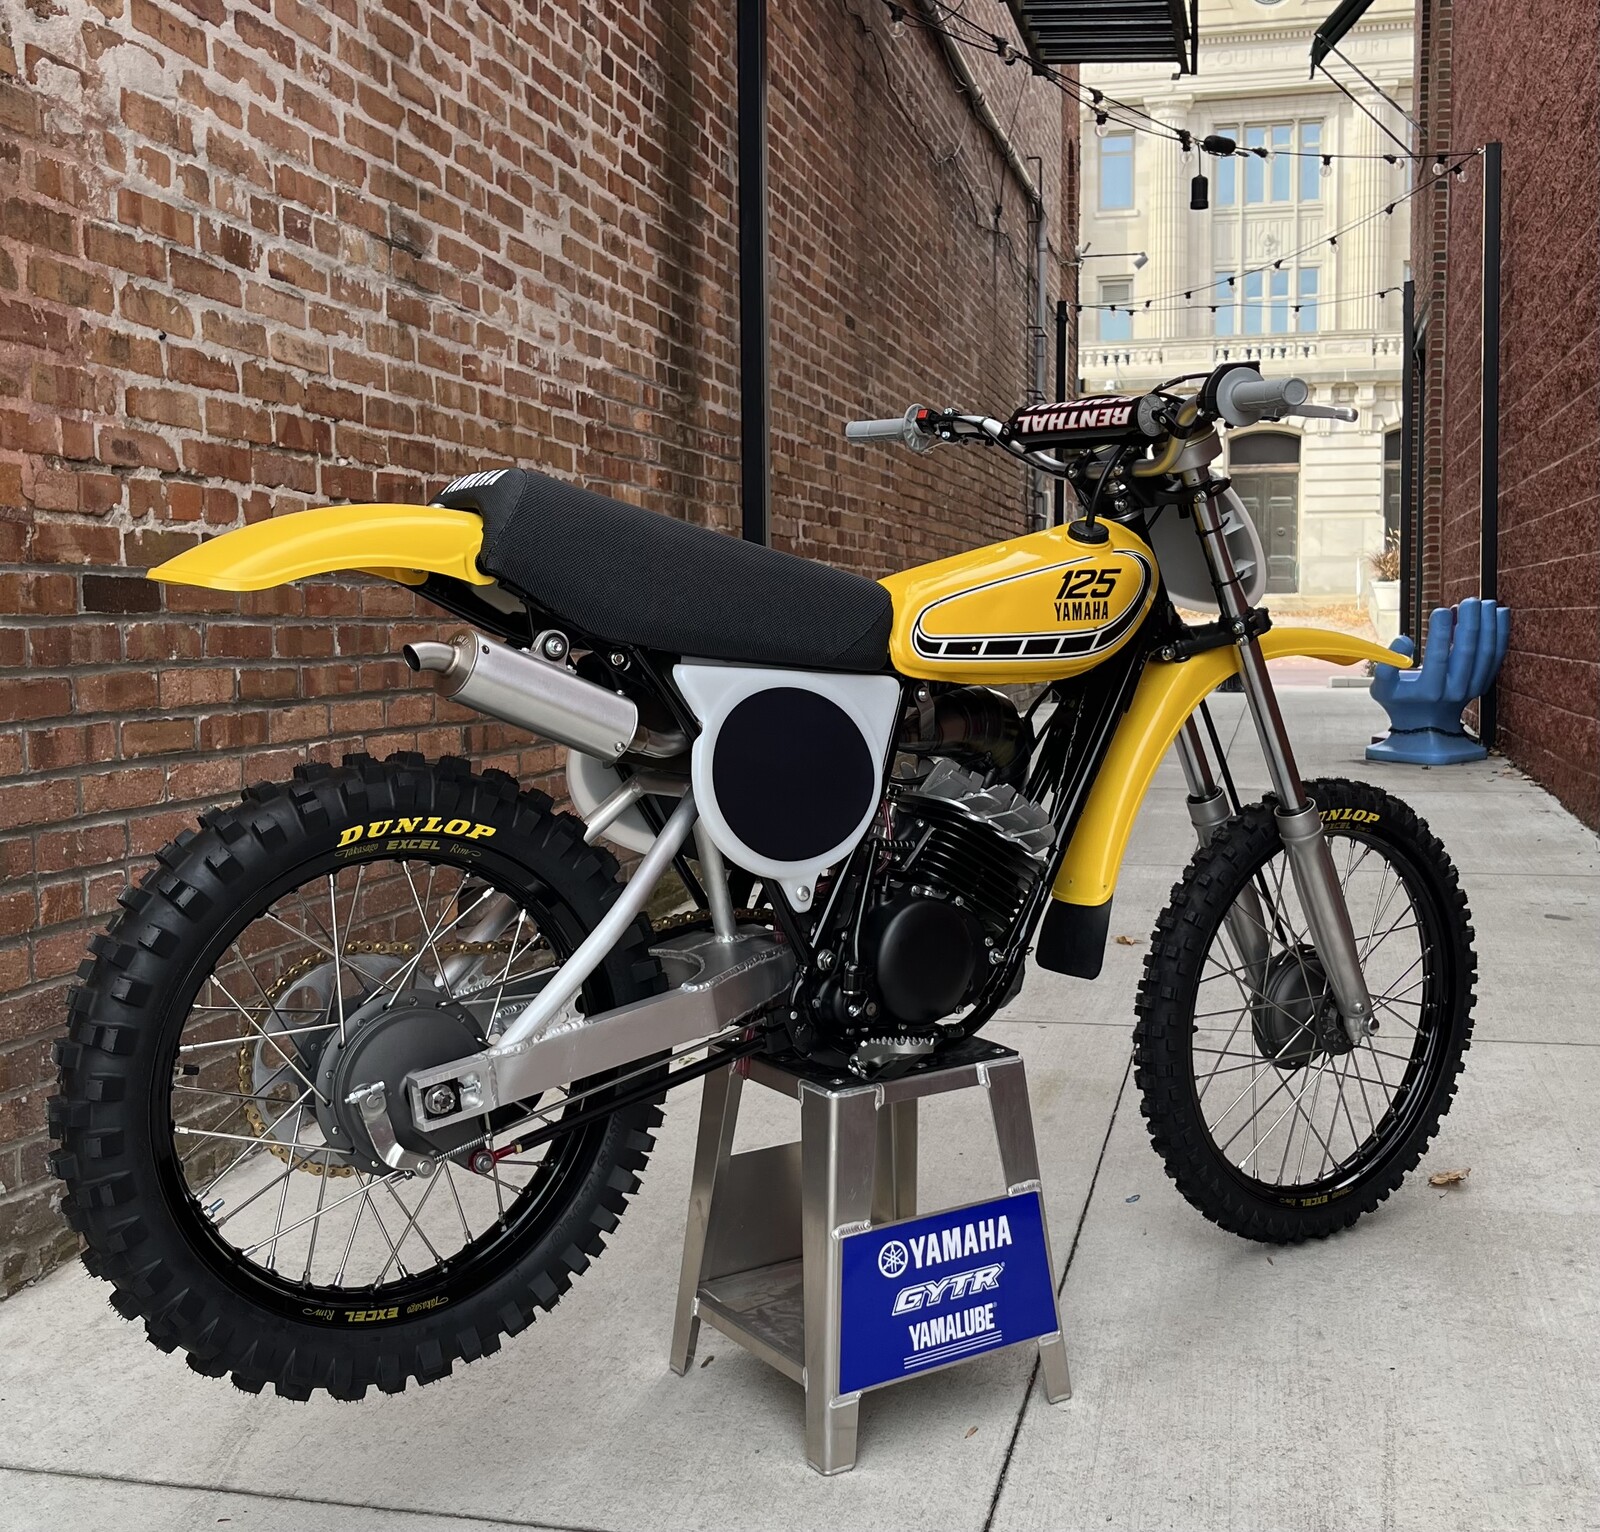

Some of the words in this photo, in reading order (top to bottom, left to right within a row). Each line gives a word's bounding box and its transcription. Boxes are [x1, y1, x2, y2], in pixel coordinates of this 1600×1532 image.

[1202, 47, 1292, 67] COUNTY
[1017, 405, 1133, 434] RENTHAL
[441, 469, 509, 496] YAMAHA
[1056, 568, 1122, 600] 125
[1054, 600, 1109, 622] YAMAHA
[1318, 808, 1380, 824] UNLOP
[336, 816, 497, 848] DUNLOP
[386, 839, 441, 851] EXCEL
[909, 1214, 1013, 1270] YAMAHA
[891, 1262, 1004, 1317] GYTR
[344, 1306, 400, 1323] EXCEL
[908, 1302, 996, 1352] YAMALUBE
